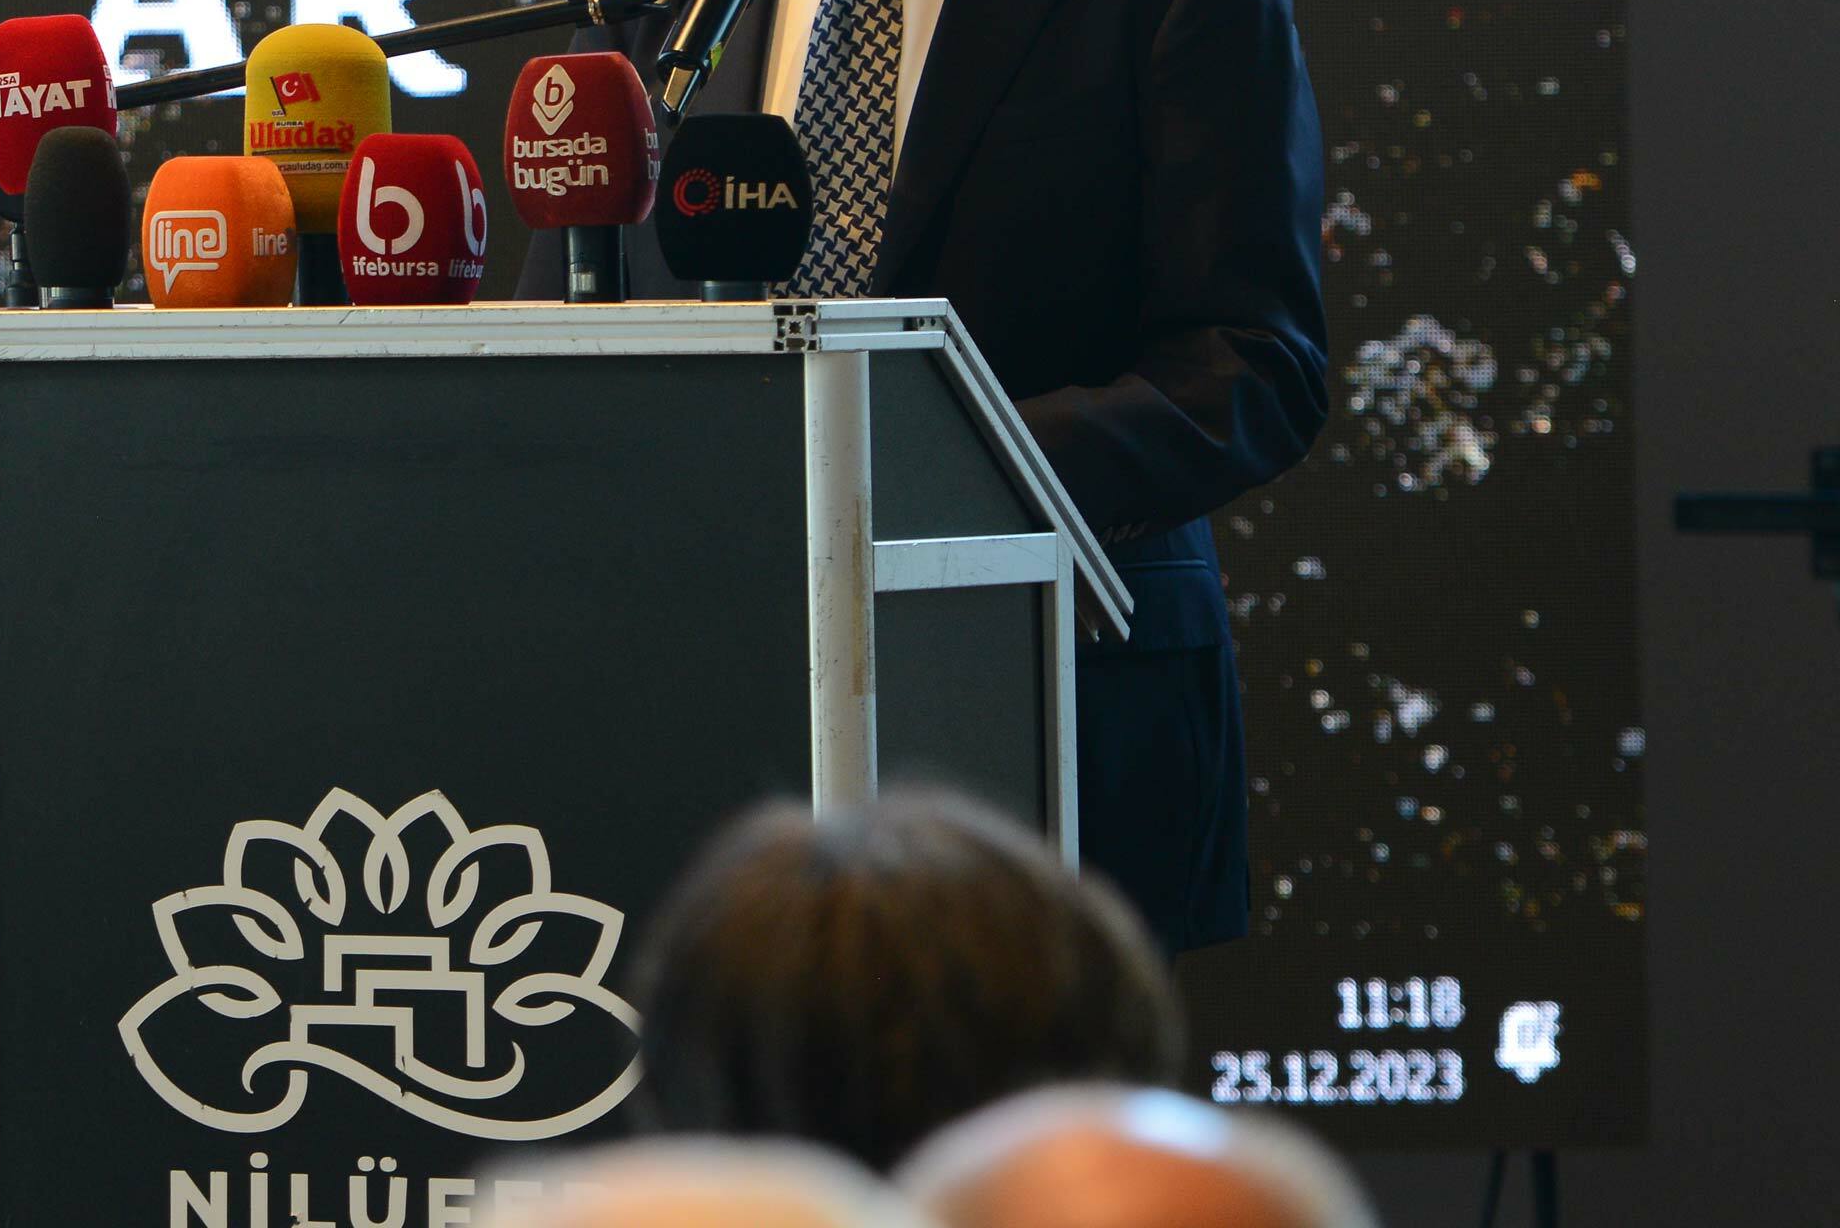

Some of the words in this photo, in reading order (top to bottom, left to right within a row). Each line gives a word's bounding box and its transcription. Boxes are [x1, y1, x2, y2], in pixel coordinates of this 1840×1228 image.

[250, 118, 355, 154] Uludağ
[513, 132, 607, 158] bursada
[514, 159, 609, 196] bugün
[157, 220, 219, 260] line
[251, 227, 288, 256] line
[1335, 976, 1465, 1030] 11:18
[1210, 1048, 1465, 1103] 25.12.2023
